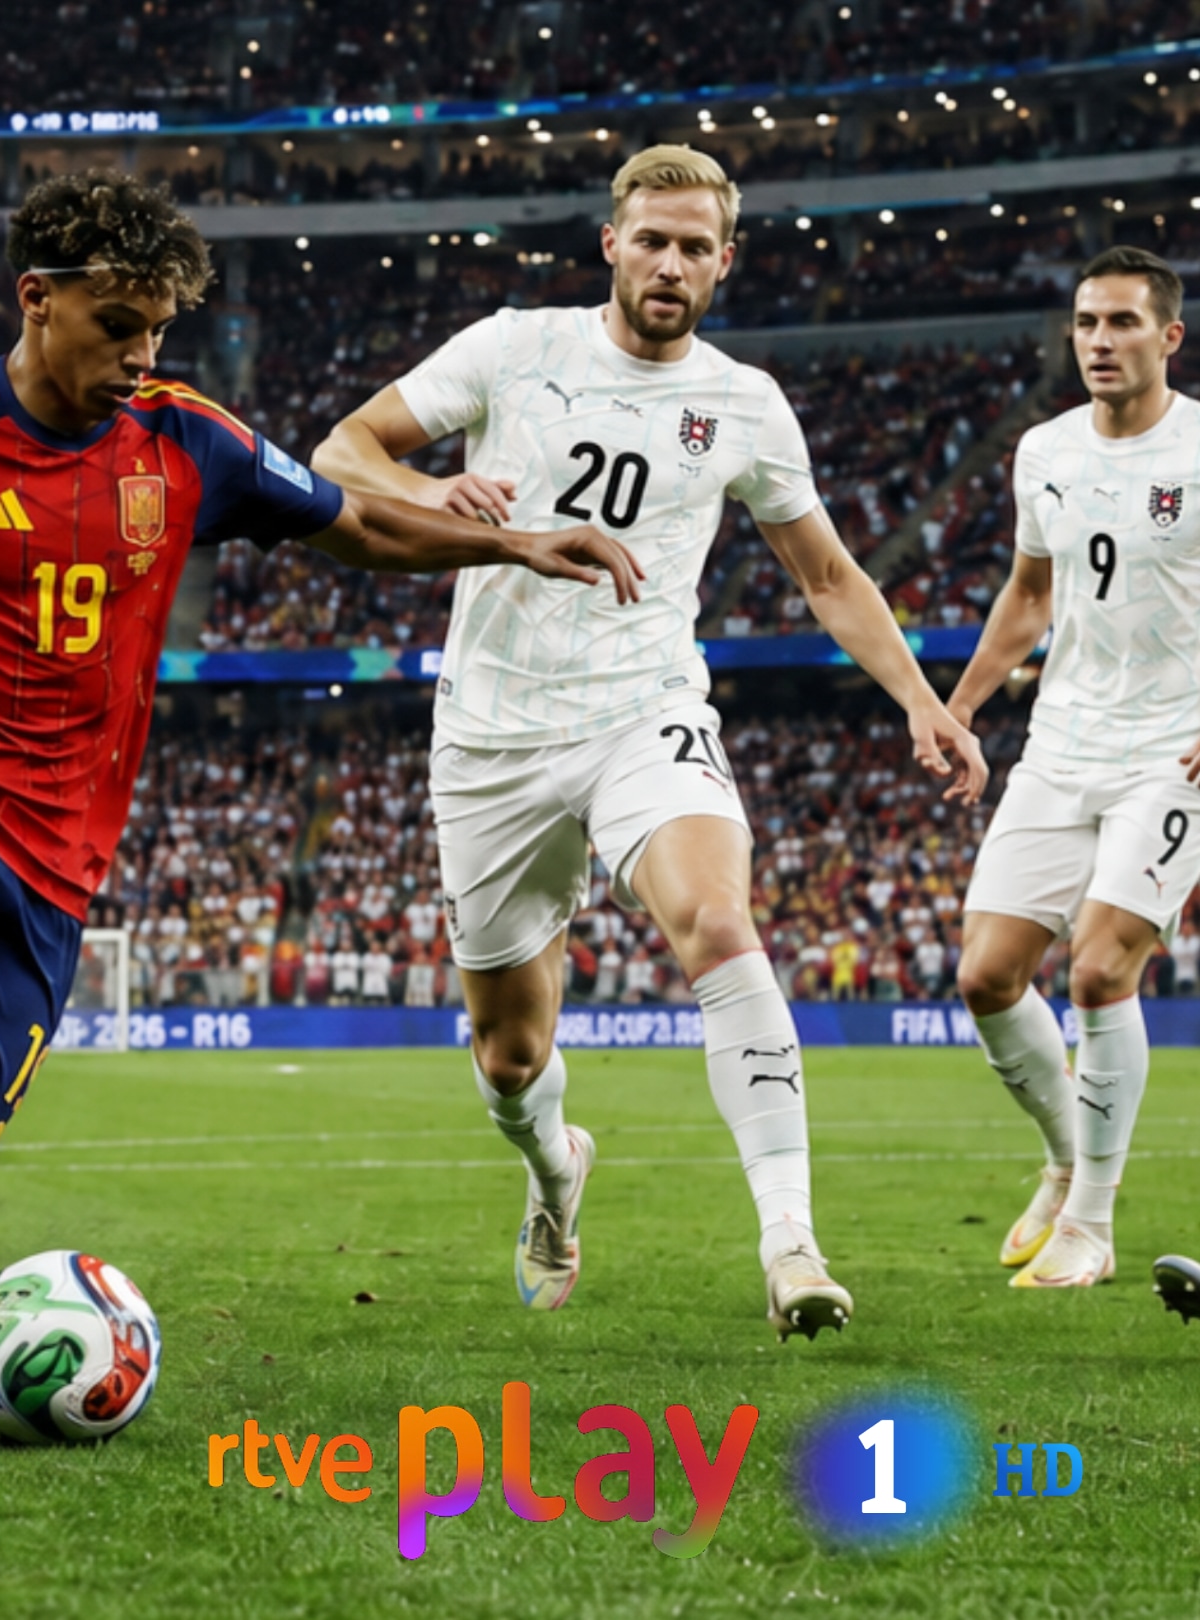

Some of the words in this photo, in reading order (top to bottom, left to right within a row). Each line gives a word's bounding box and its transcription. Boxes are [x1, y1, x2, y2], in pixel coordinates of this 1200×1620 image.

[554, 441, 650, 529] 20
[1089, 533, 1117, 601] 9
[32, 561, 107, 654] 19
[1158, 809, 1189, 866] 9
[193, 1013, 252, 1047] R16
[892, 1008, 948, 1043] FIFA
